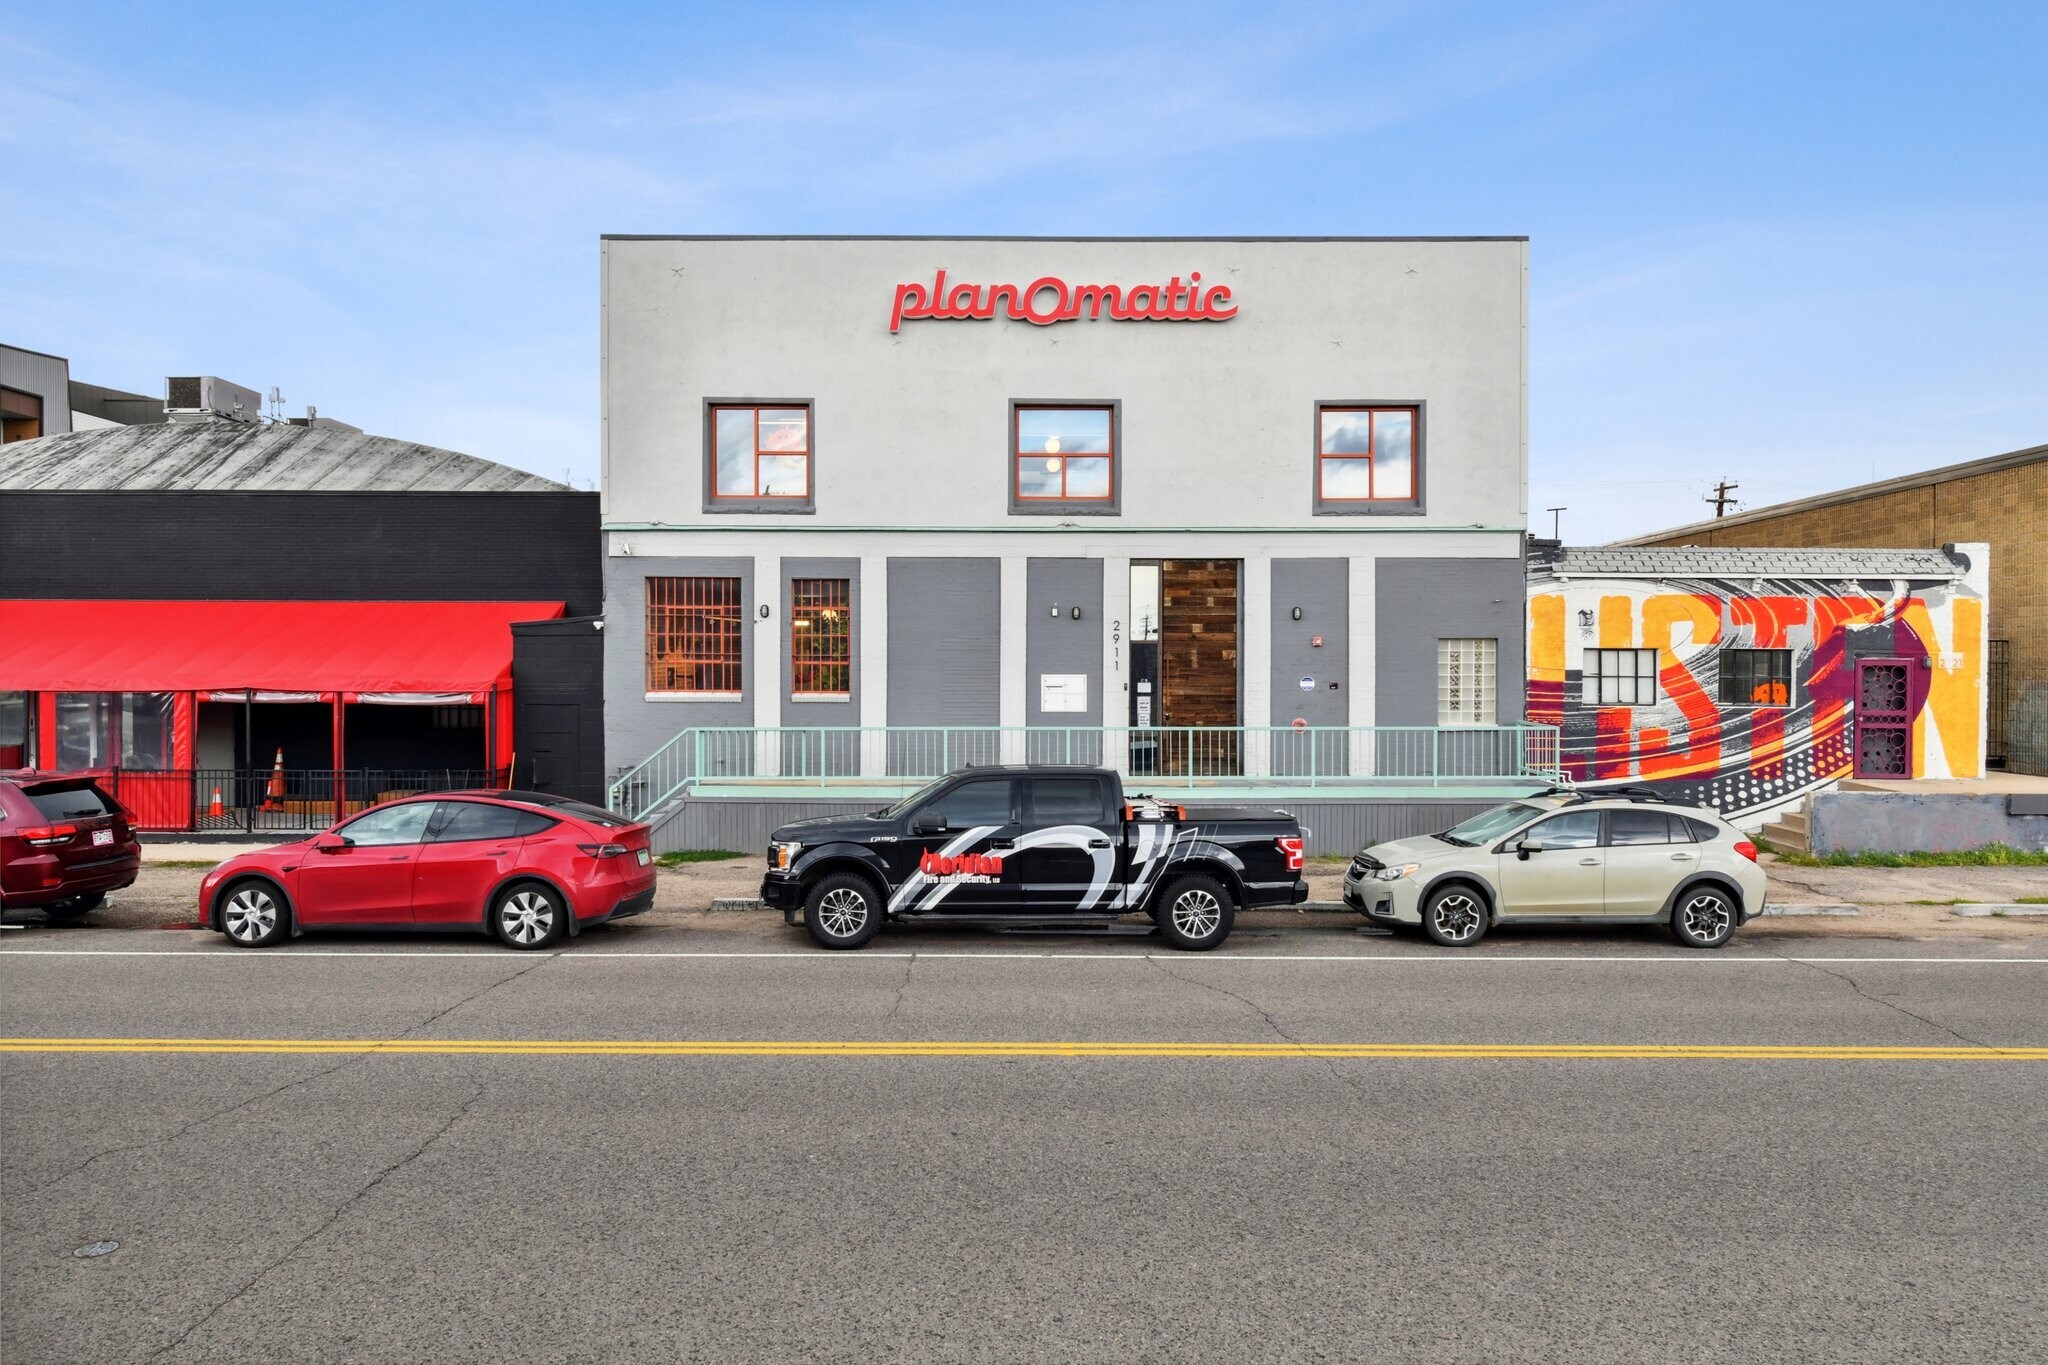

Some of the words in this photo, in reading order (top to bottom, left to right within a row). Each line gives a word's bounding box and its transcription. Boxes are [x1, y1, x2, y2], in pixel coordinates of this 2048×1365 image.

[1112, 620, 1121, 671] 2911
[1940, 658, 1962, 668] 221
[920, 849, 1003, 875] Meridian
[923, 875, 939, 884] Fire
[940, 875, 955, 884] and
